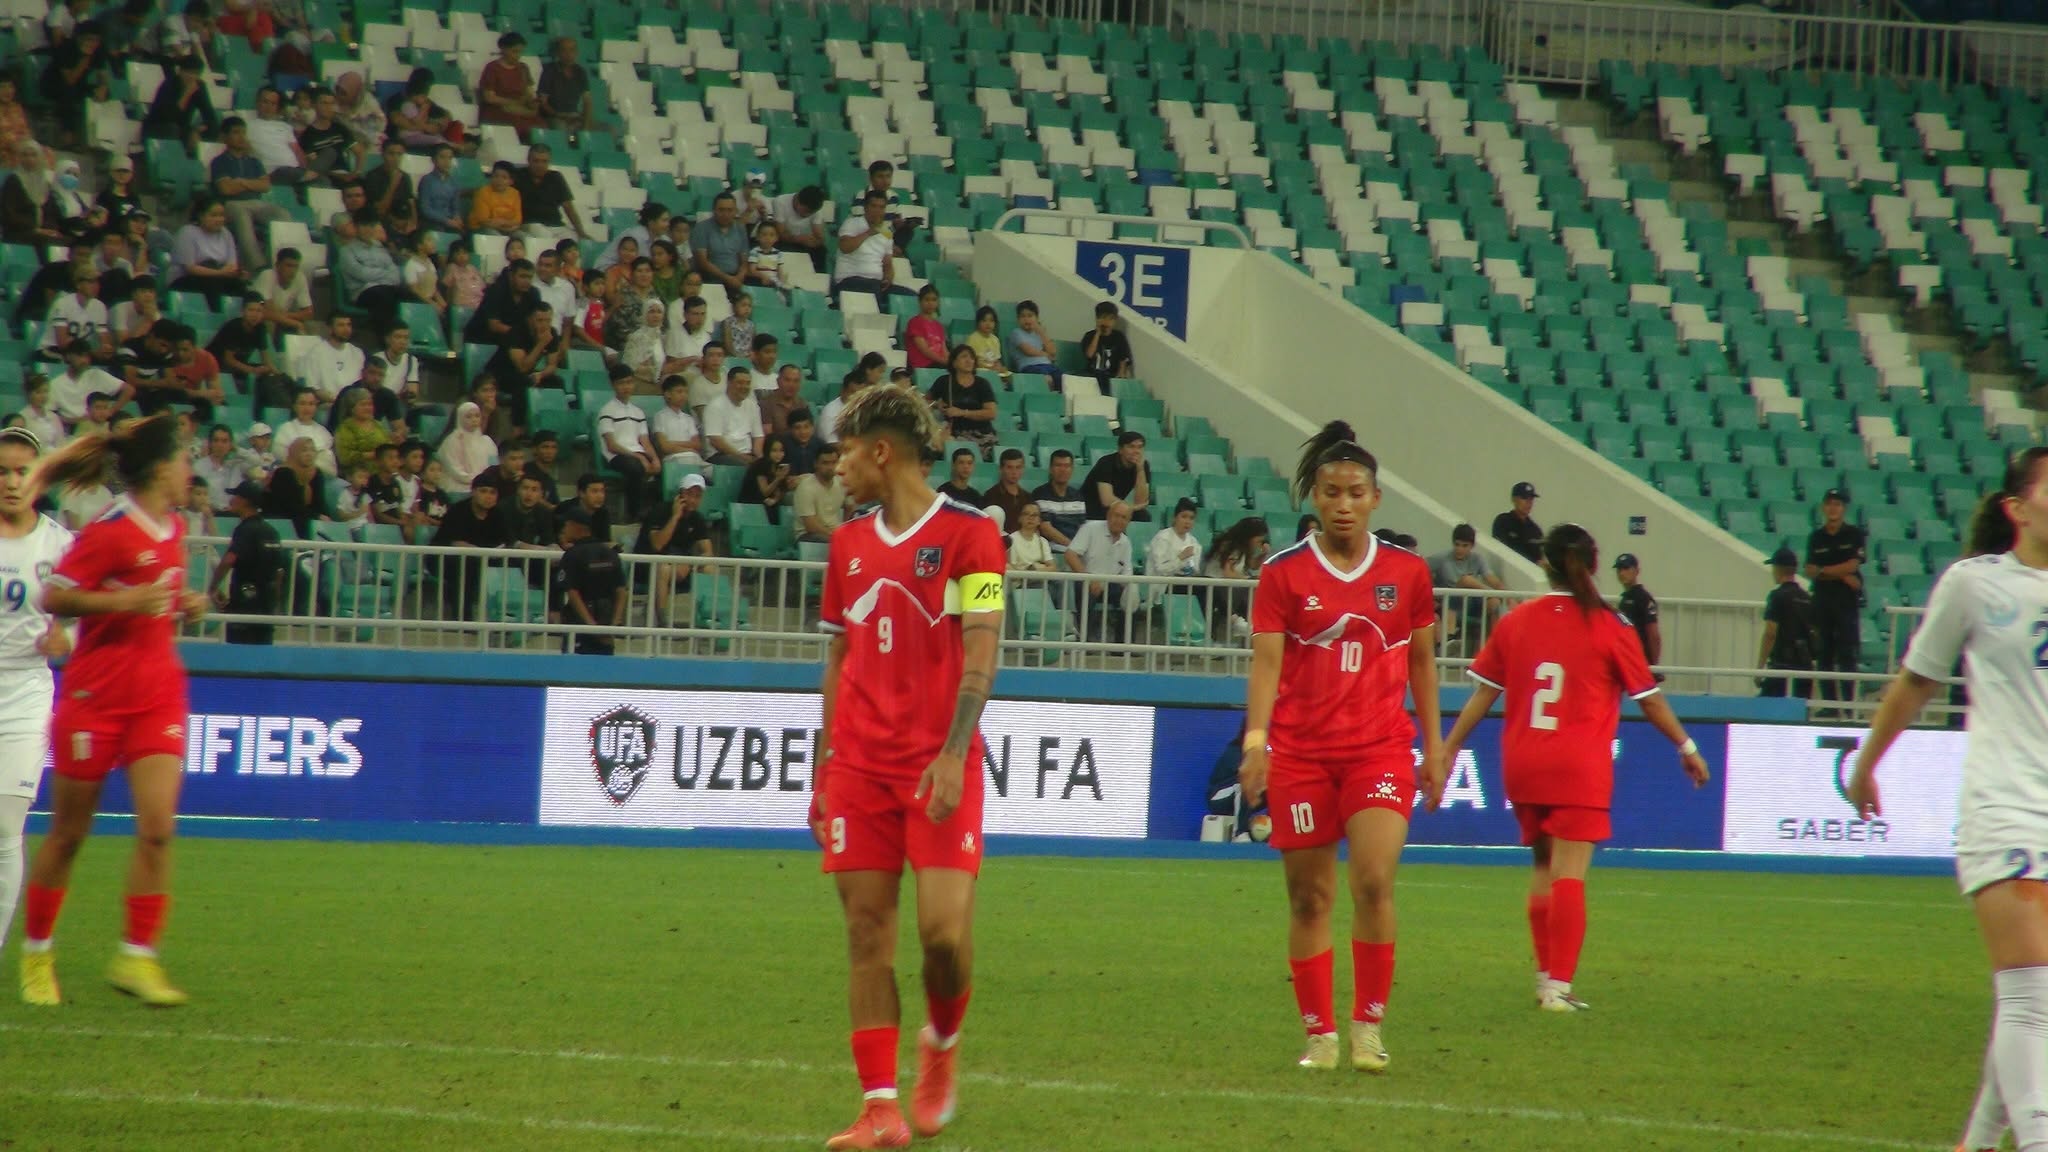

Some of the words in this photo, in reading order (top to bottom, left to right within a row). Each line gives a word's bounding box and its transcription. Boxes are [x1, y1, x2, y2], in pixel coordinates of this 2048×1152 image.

[1100, 252, 1165, 307] 3E
[0, 578, 27, 612] 9
[974, 582, 1003, 600] AF
[877, 616, 893, 653] 9
[1340, 641, 1363, 672] 10
[1530, 661, 1565, 730] 2
[184, 714, 363, 777] IFIERS
[1036, 736, 1103, 800] FA
[1366, 792, 1402, 803] KELME
[831, 816, 847, 854] 9
[1290, 801, 1315, 834] 10
[1778, 817, 1890, 842] SABER
